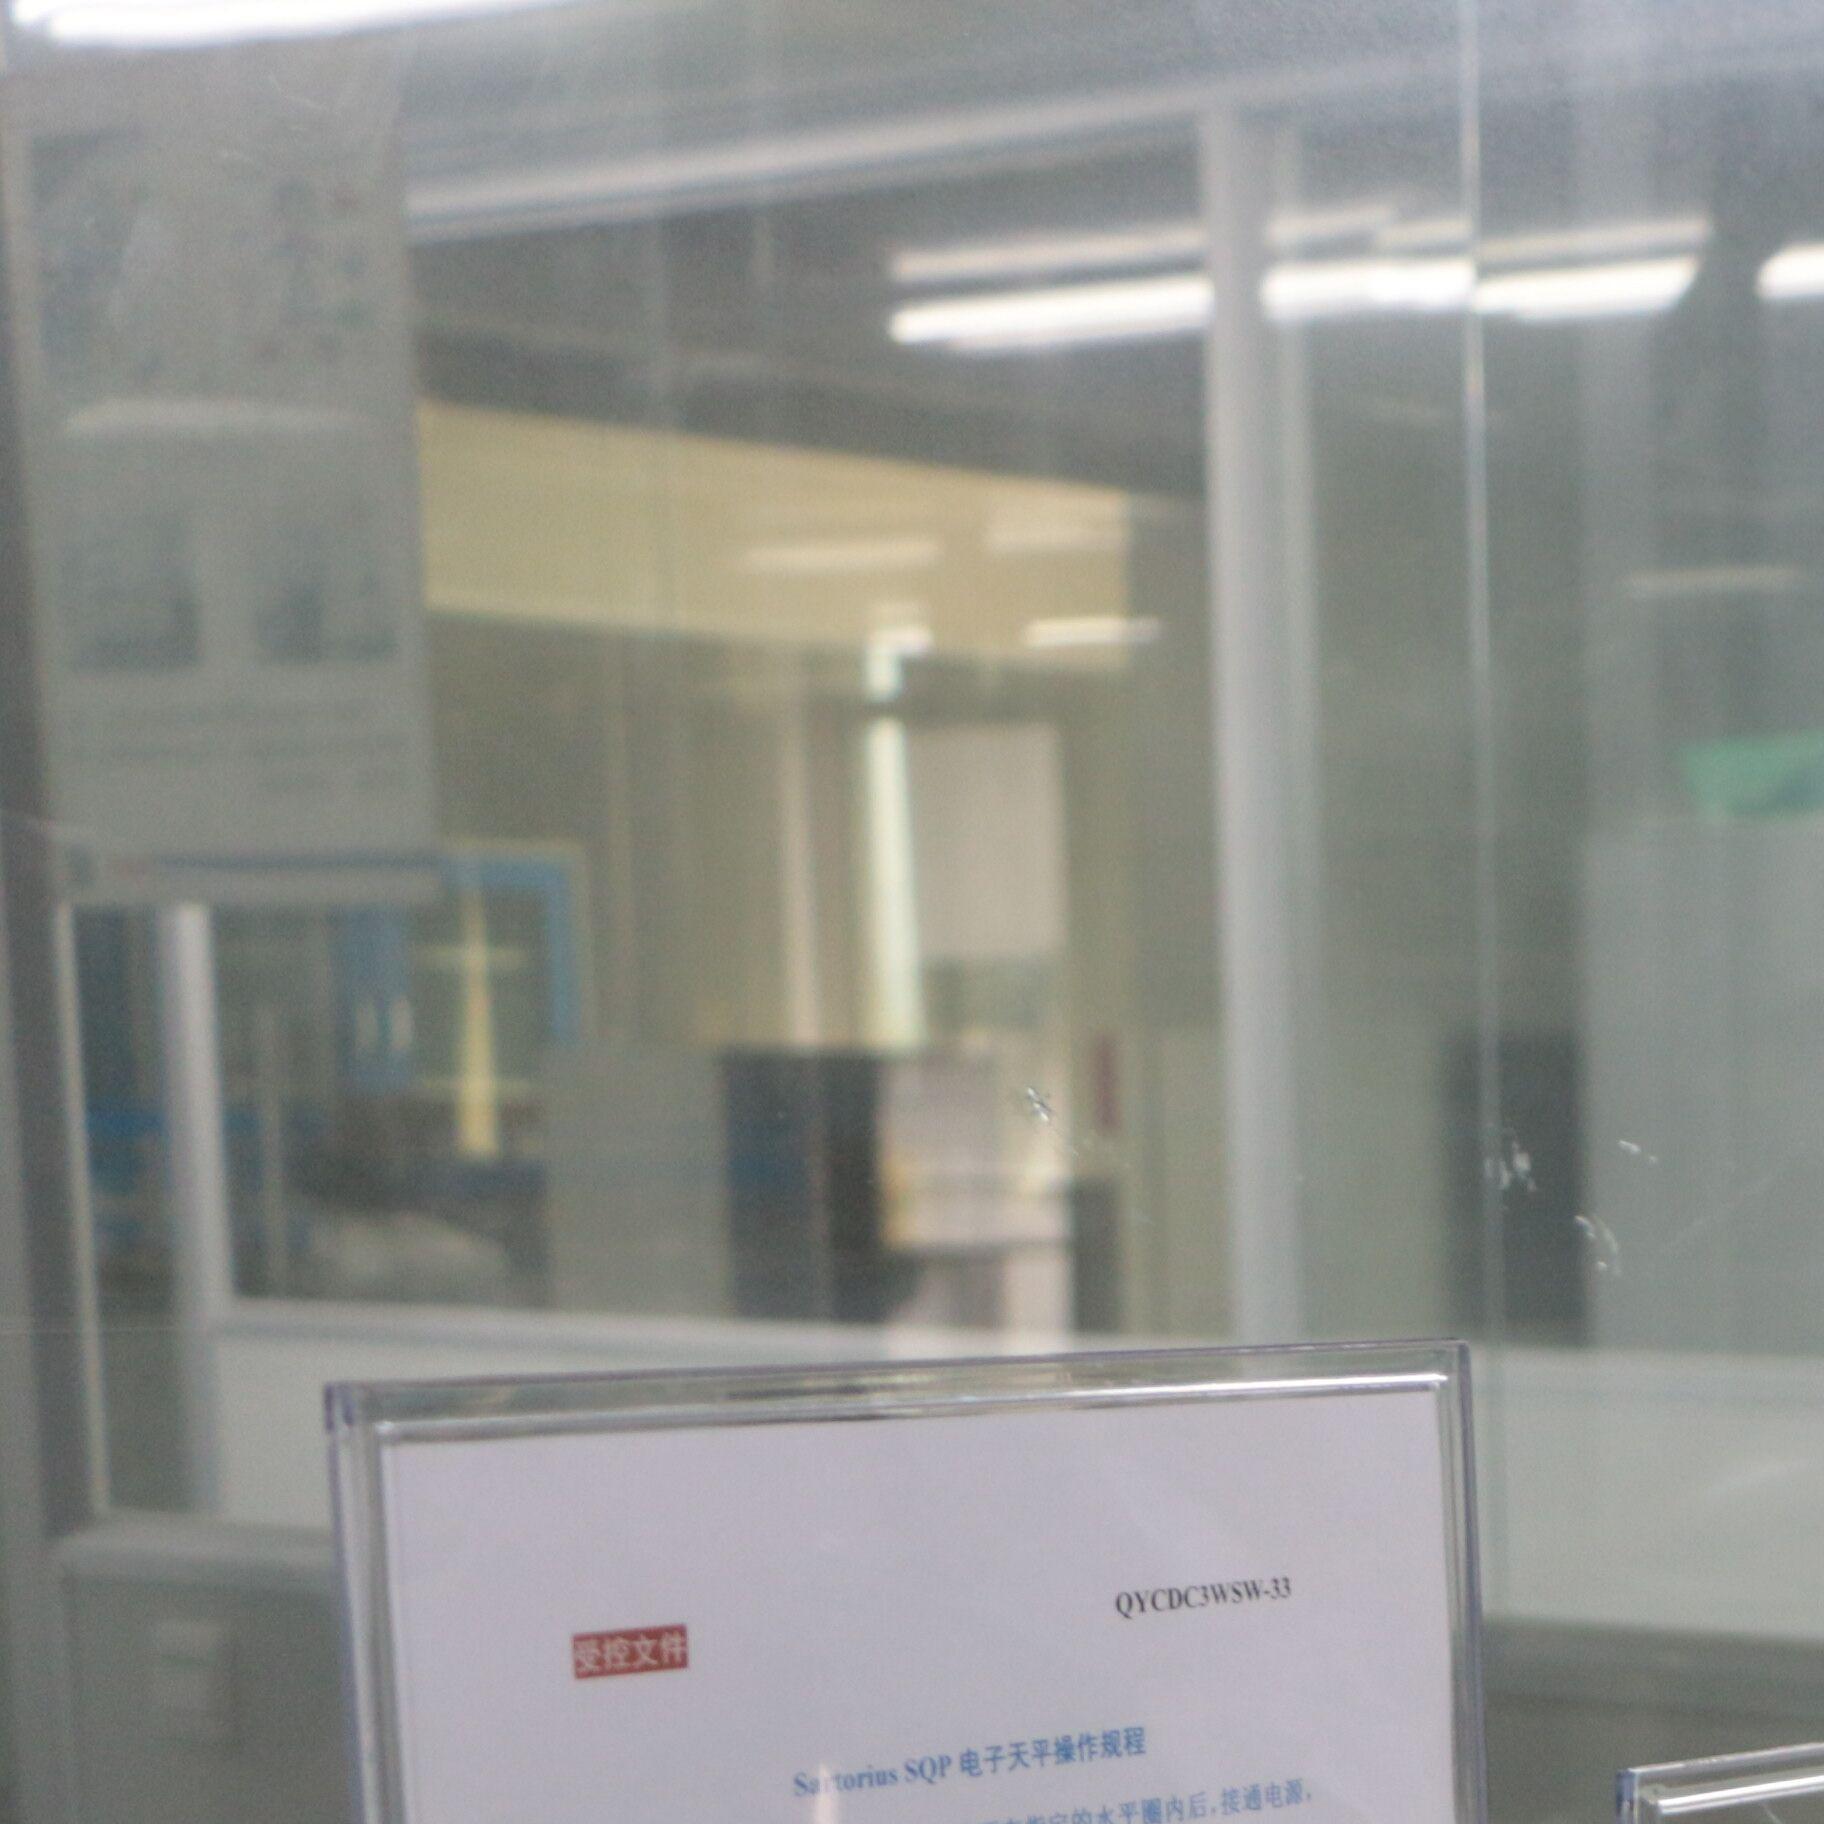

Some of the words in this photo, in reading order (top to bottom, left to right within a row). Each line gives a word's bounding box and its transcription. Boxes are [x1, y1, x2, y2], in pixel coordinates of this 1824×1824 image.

[574, 1630, 683, 1672] 受控文件
[903, 1755, 952, 1788] SQP
[958, 1726, 1147, 1780] 电子天平操作规程
